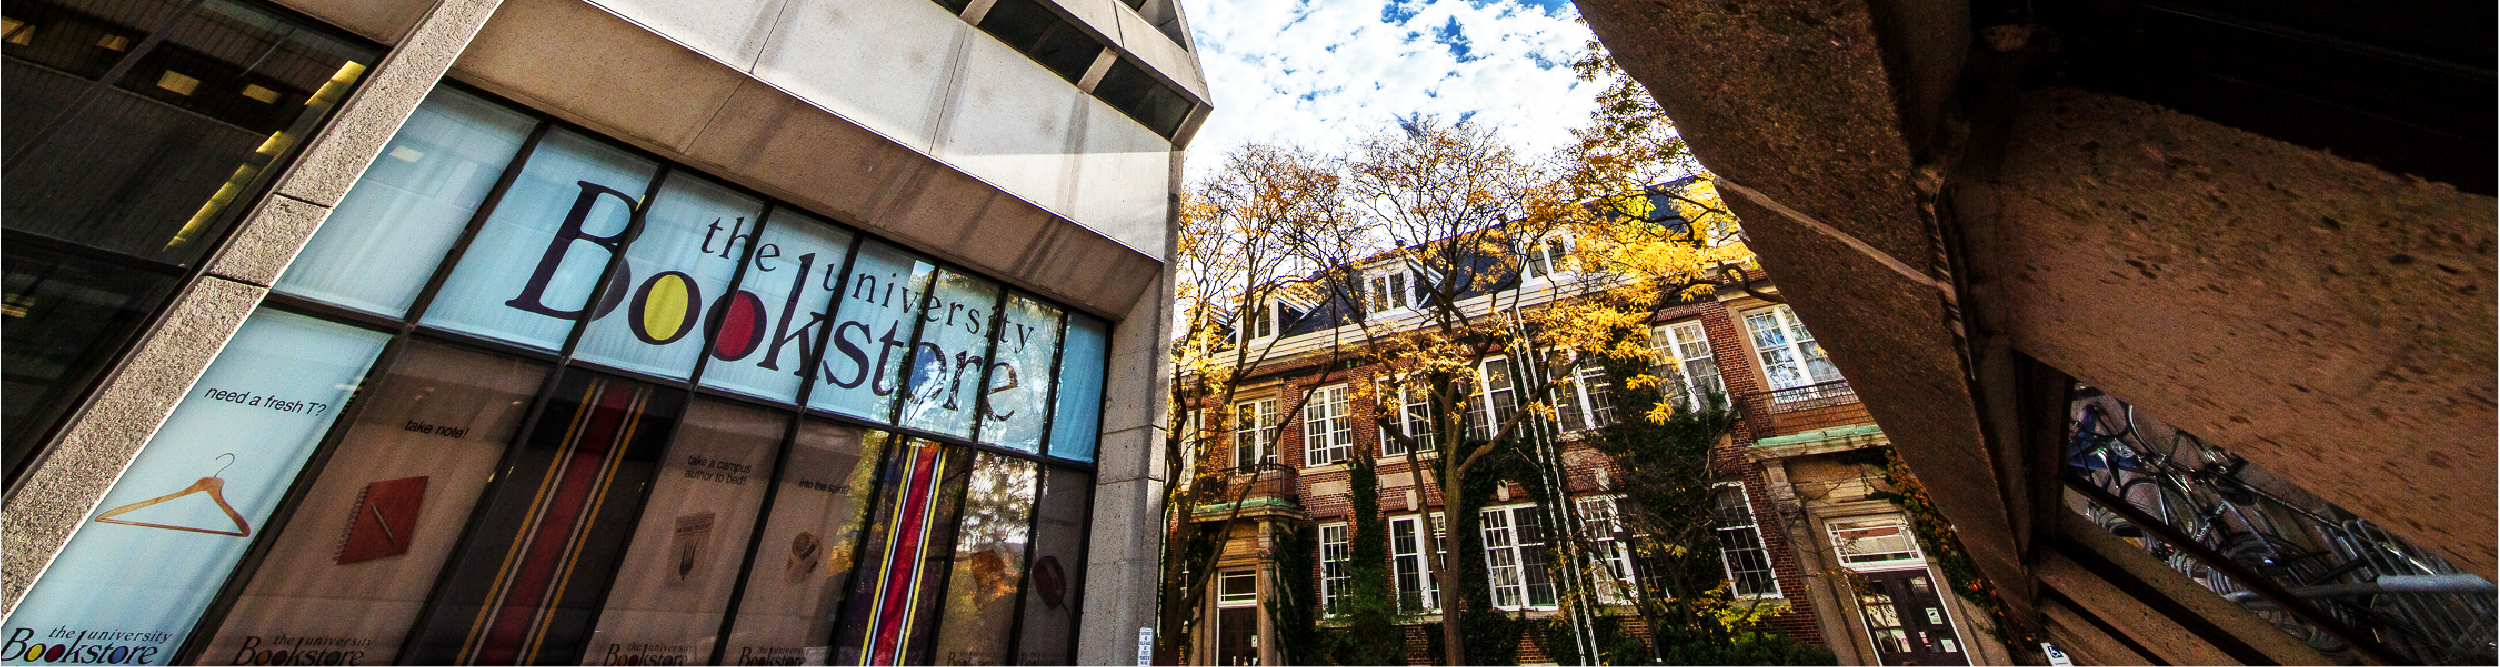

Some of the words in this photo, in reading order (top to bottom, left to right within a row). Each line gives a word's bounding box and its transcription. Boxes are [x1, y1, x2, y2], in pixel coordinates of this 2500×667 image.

[701, 216, 780, 272] the
[822, 262, 1036, 352] university
[505, 180, 1019, 422] Bookstore
[204, 387, 251, 404] need
[248, 395, 262, 407] a
[264, 395, 304, 414] fresh
[307, 402, 327, 416] T?
[405, 419, 433, 434] take
[435, 424, 469, 439] note!
[687, 455, 707, 467] take
[708, 460, 716, 468] a
[717, 461, 752, 474] campus
[684, 470, 714, 481] author
[715, 472, 725, 483] to
[726, 473, 747, 486] bed!
[1, 627, 158, 665] Bookstore
[48, 625, 75, 638] the
[87, 628, 173, 644] university
[273, 634, 295, 646] the
[304, 636, 375, 648] university
[231, 635, 365, 667] Bookstore
[603, 643, 688, 667] Bookstore
